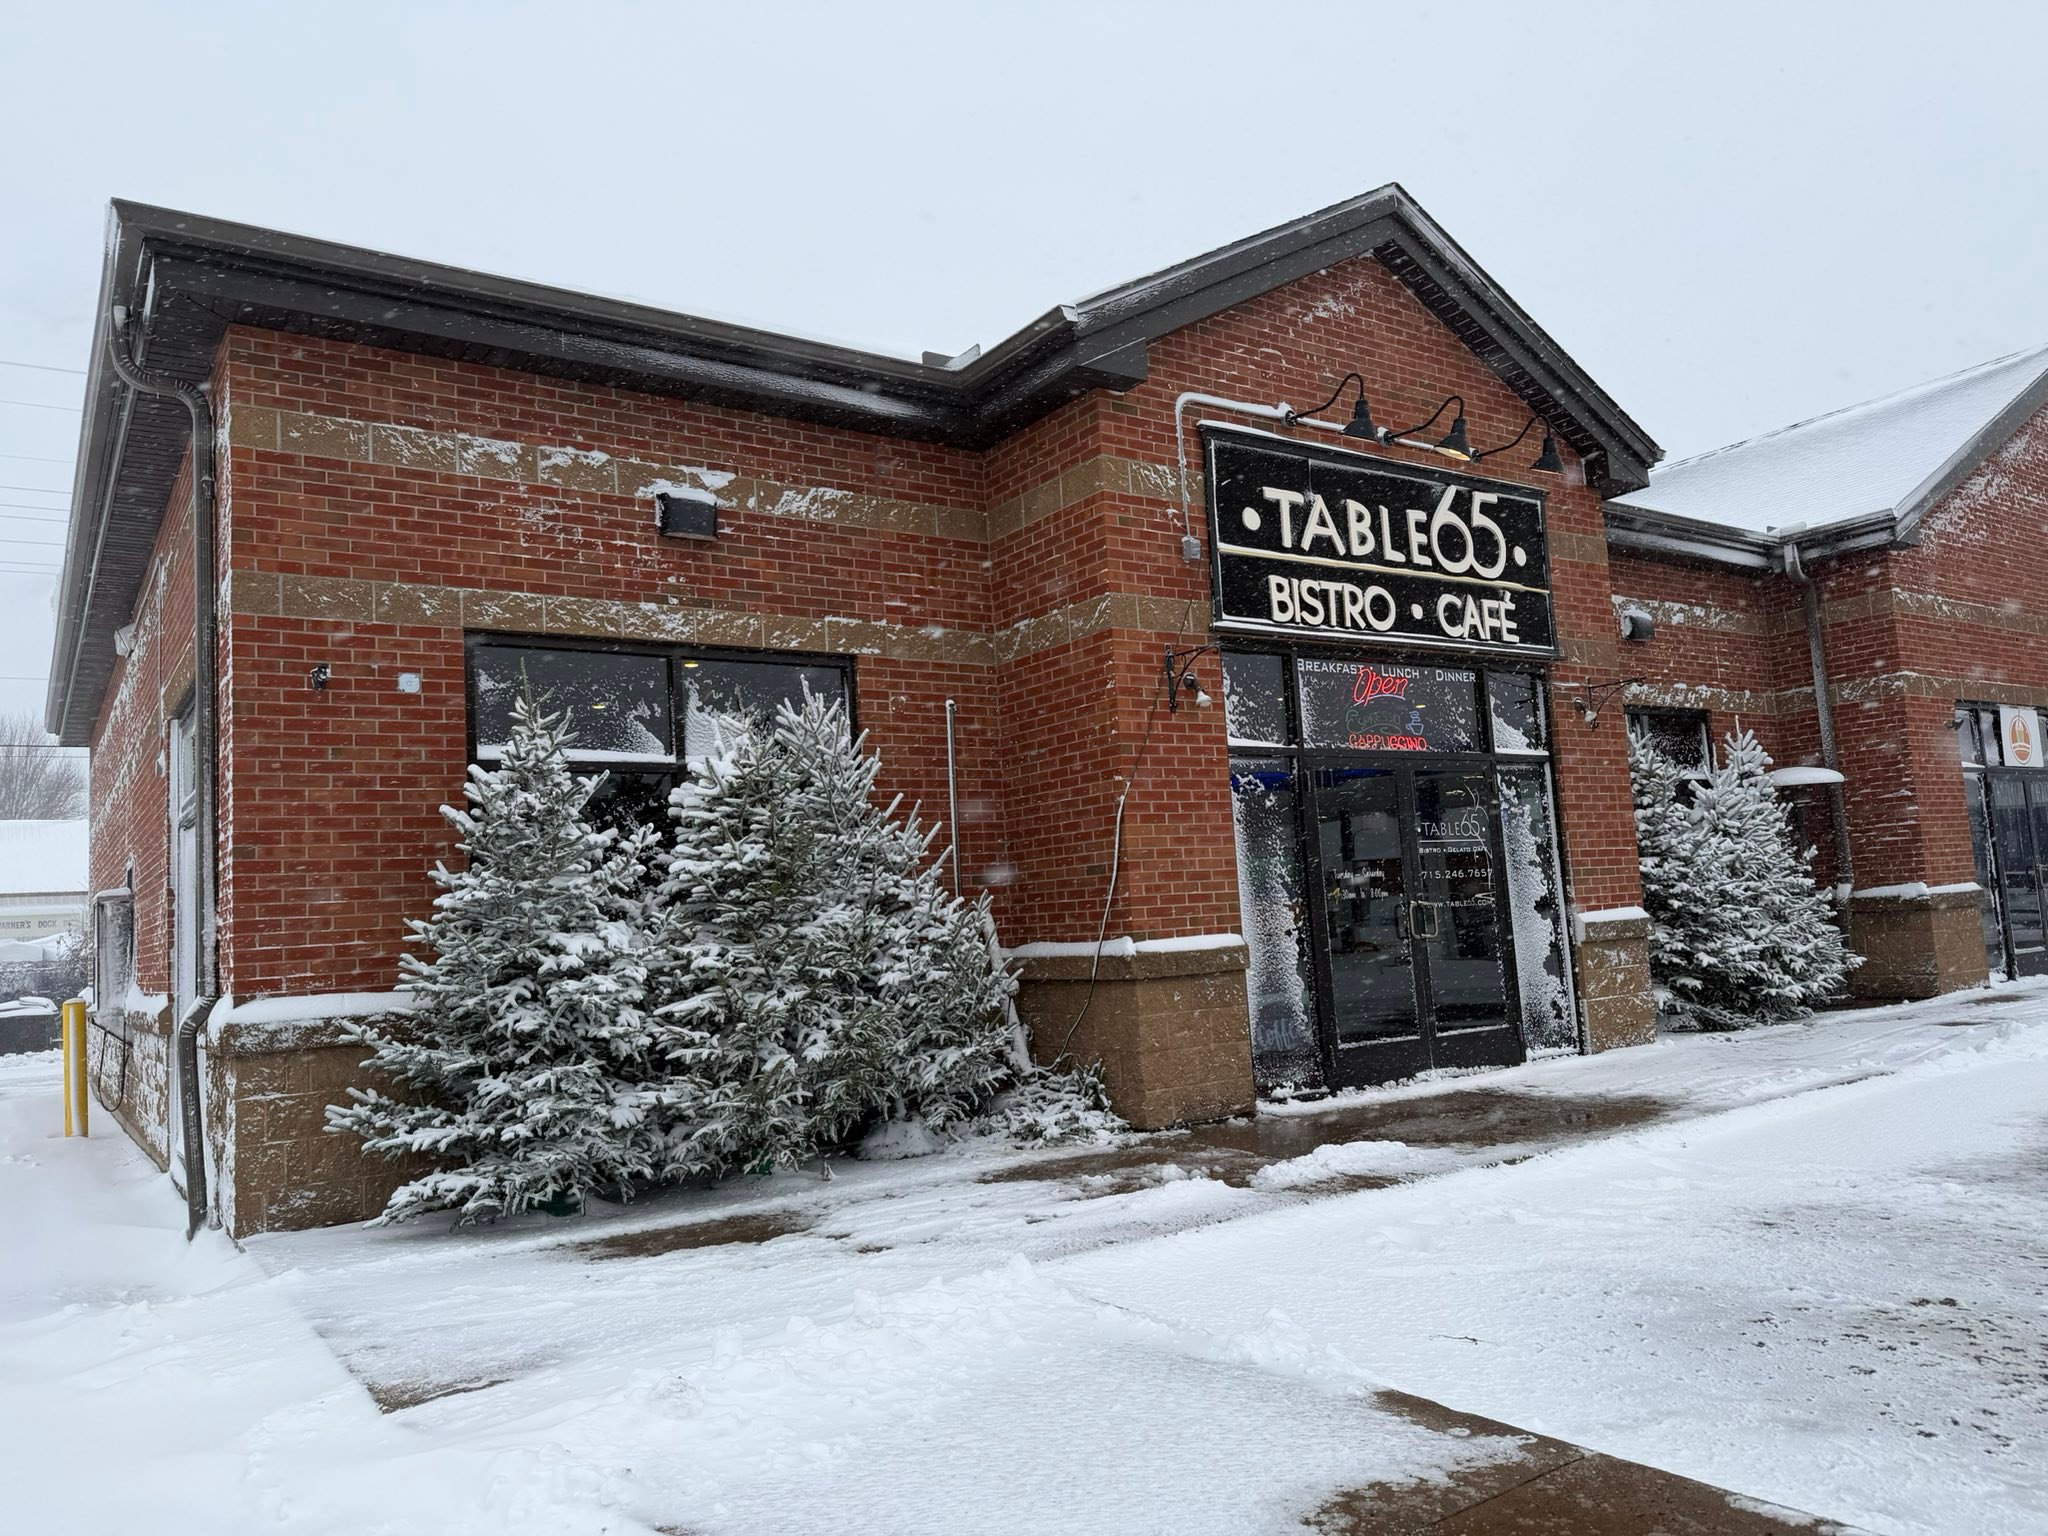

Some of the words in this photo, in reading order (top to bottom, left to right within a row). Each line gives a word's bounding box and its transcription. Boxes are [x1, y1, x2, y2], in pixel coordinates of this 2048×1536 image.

[1262, 485, 1506, 579] TABLE65
[1268, 575, 1396, 631] BISTRO
[1297, 658, 1365, 674] BREAKFAST
[1381, 665, 1420, 679] LUNCH
[1435, 669, 1476, 682] DINNER
[1353, 668, 1408, 706] Open
[1421, 813, 1480, 836] TABLE65
[38, 919, 57, 928] DOCK
[1256, 1018, 1299, 1052] Coffe
